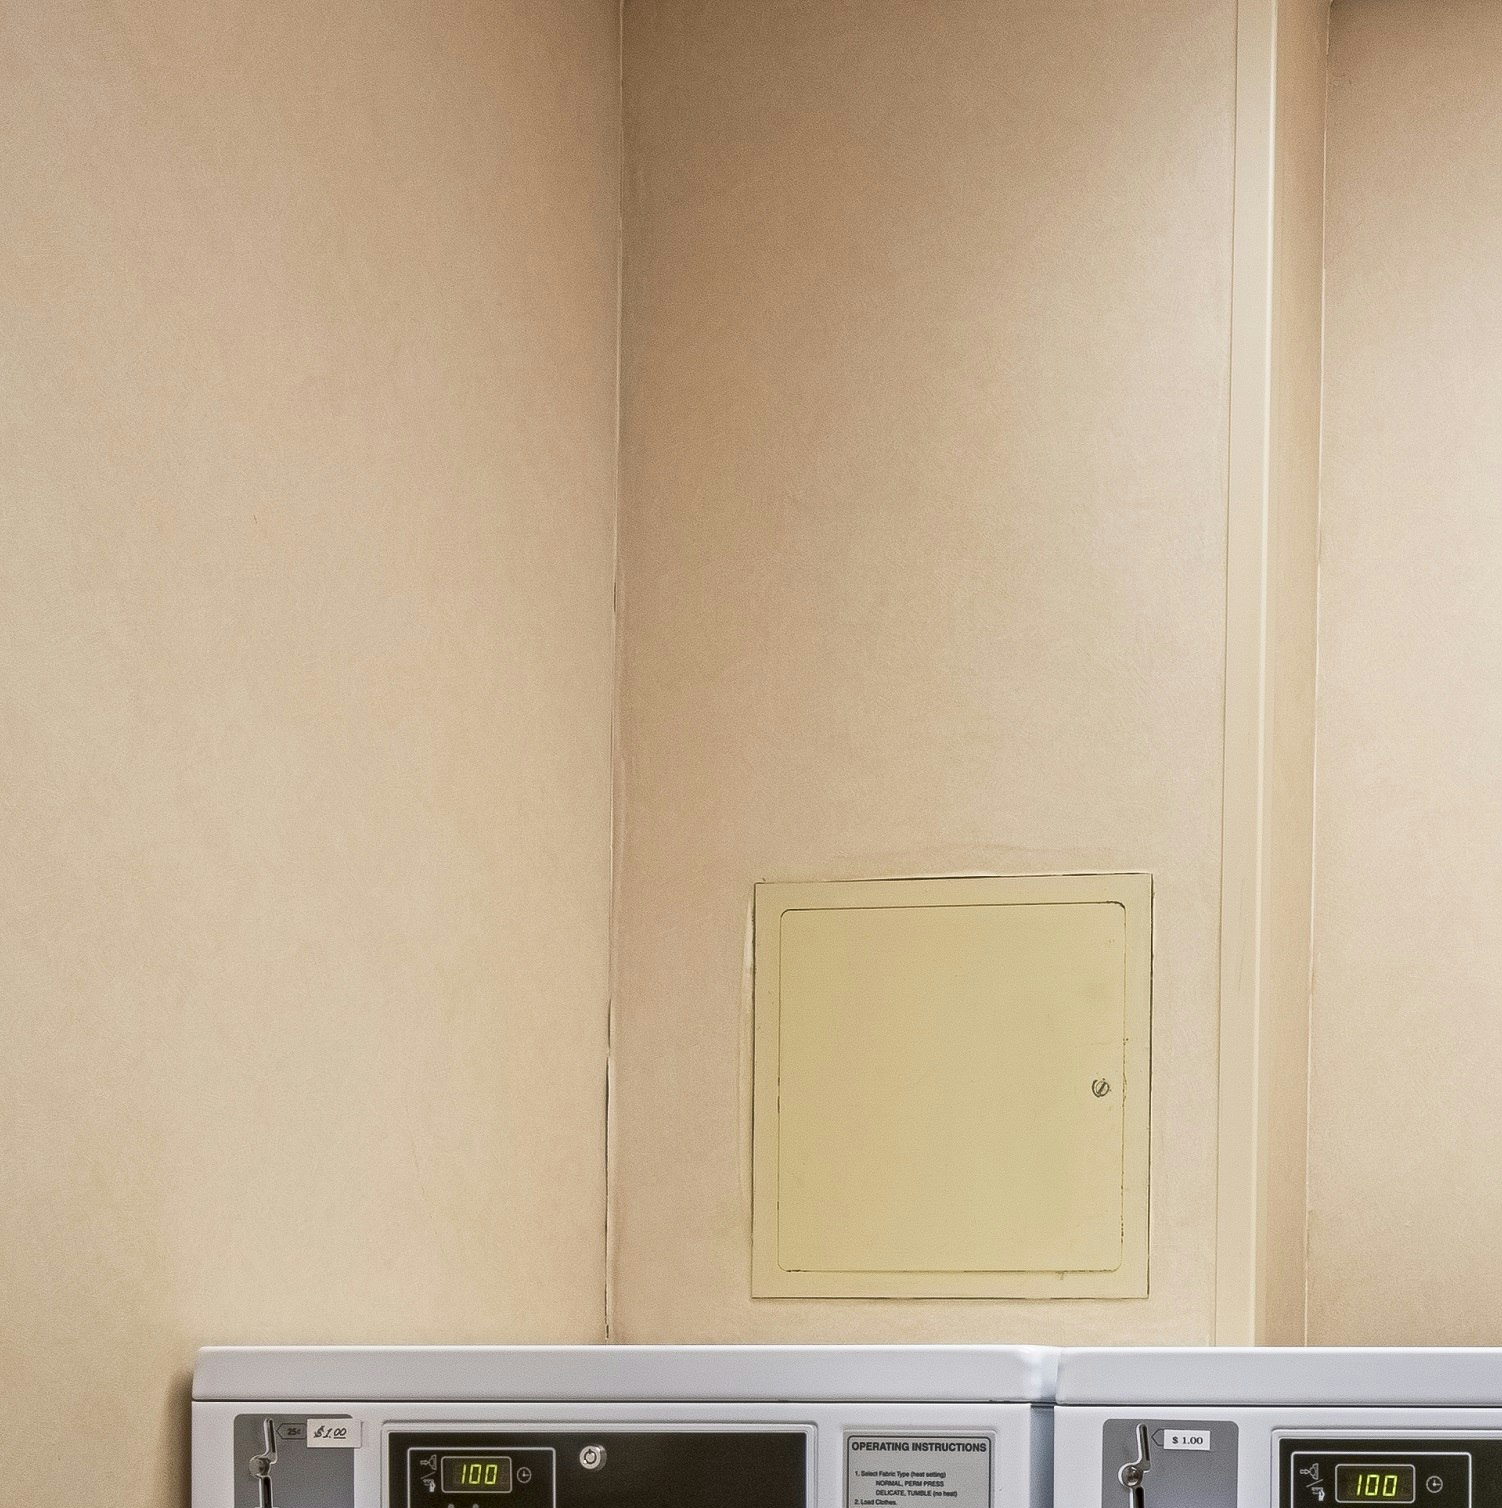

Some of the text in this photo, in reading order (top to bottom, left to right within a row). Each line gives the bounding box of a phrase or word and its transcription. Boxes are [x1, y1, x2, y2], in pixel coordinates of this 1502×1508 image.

[314, 1425, 347, 1438] $1.00
[851, 1442, 987, 1452] OPERATING INSTRUCTIONS
[1172, 1436, 1203, 1445] $ 1.00
[461, 1464, 498, 1485] 100
[1356, 1474, 1398, 1497] 100
